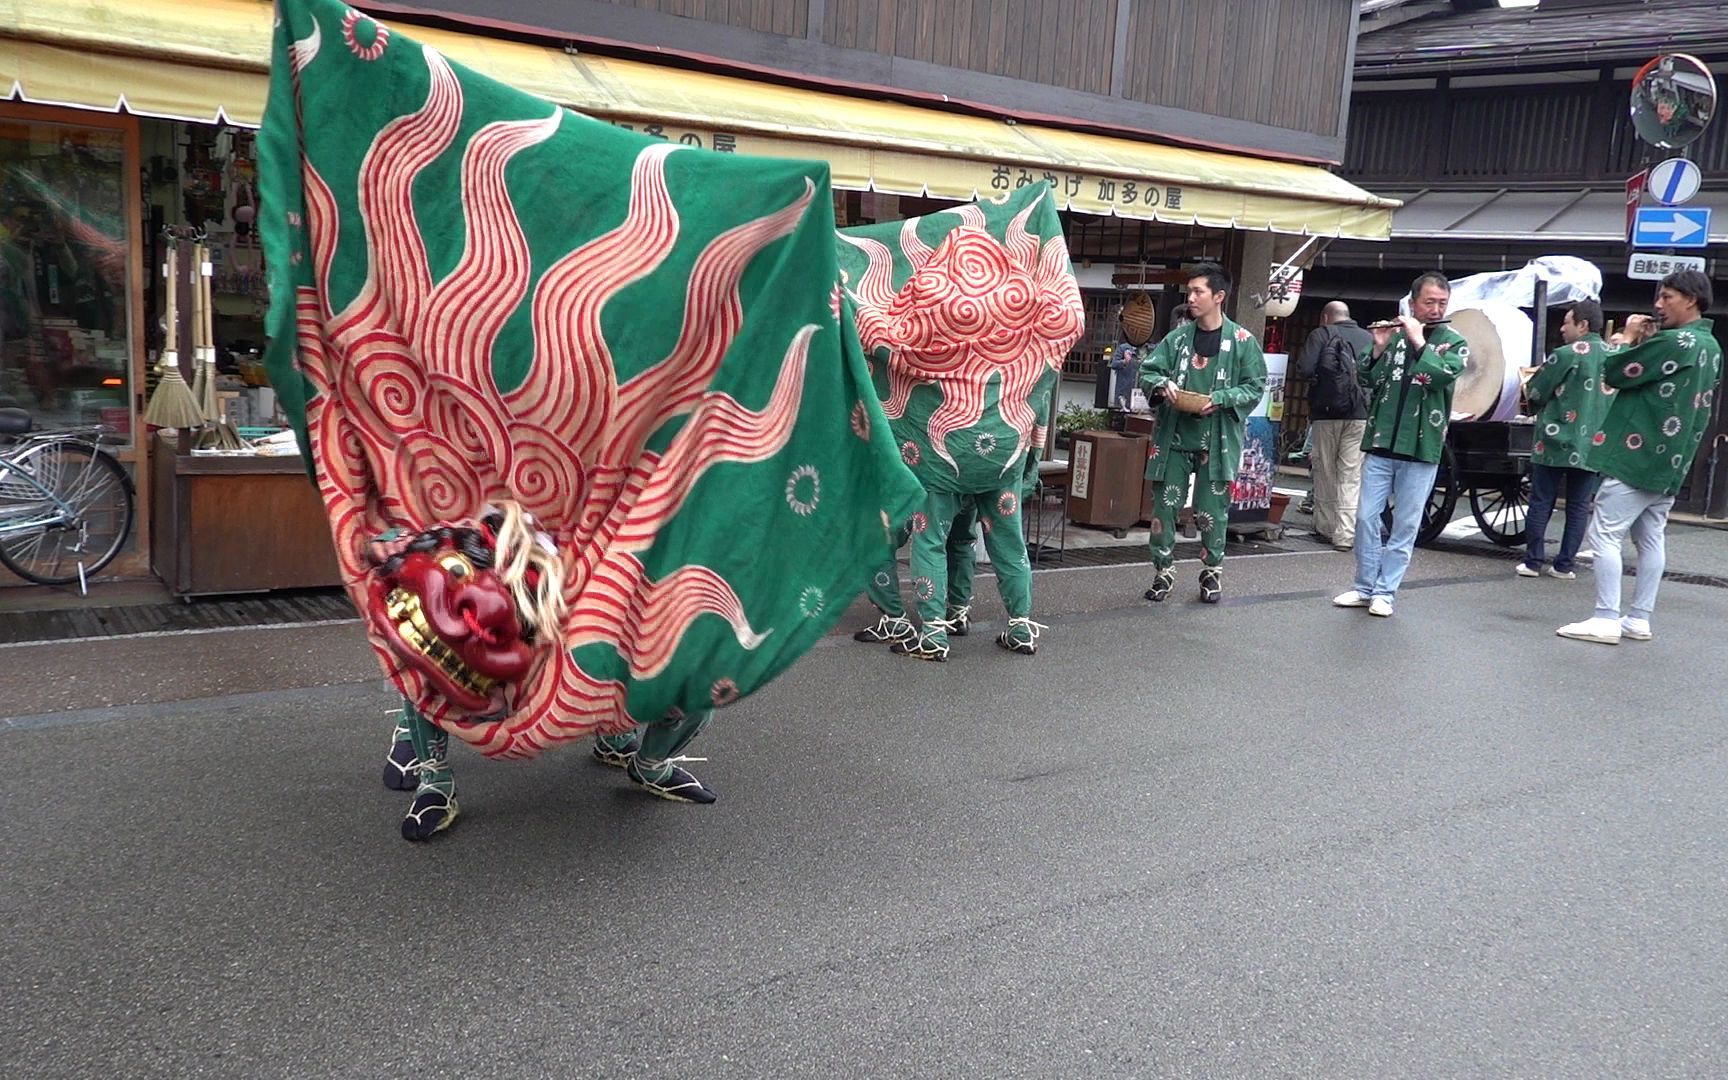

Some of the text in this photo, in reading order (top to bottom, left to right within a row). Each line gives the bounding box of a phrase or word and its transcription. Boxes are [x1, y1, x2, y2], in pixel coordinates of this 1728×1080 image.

[1098, 179, 1183, 210] 加多の屋
[1392, 338, 1407, 381] 八幡宮
